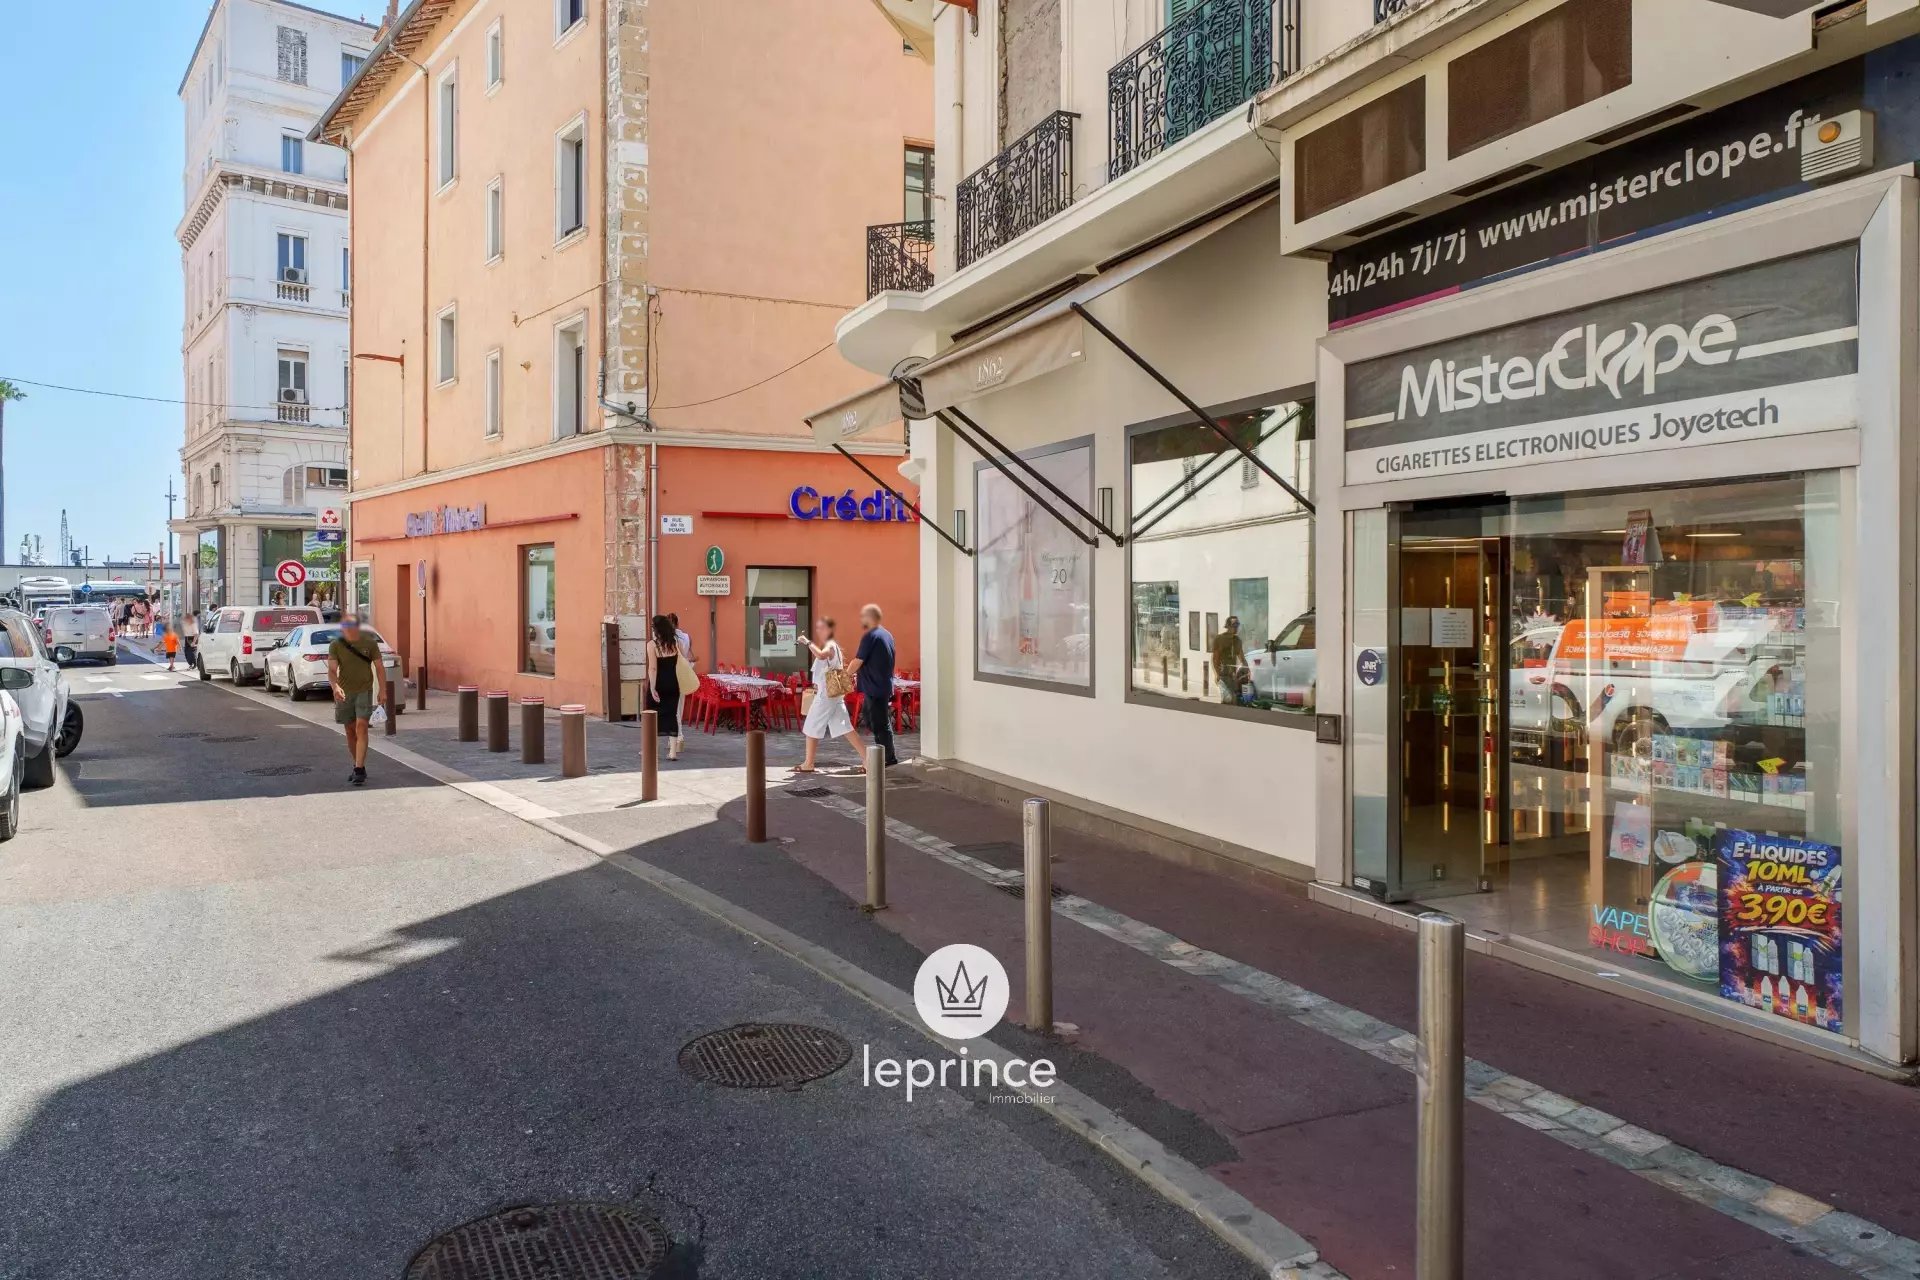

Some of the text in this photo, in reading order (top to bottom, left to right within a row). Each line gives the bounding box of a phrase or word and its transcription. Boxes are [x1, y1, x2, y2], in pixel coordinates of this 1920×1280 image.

[1327, 252, 1405, 299] 4h/24h
[1410, 228, 1466, 276] 7j/7j
[978, 356, 1004, 382] 1862
[1376, 397, 1779, 474] CIGARETTES ELECTRONIQUES Joyetech
[790, 486, 908, 522] Crédit
[1052, 568, 1067, 584] 20
[1732, 842, 1828, 866] E-LIQUIDES
[1746, 860, 1813, 884] 10ML
[1757, 882, 1803, 896] À PARTIR DE
[1593, 903, 1649, 936] VAPE
[1737, 893, 1828, 925] 3,90€
